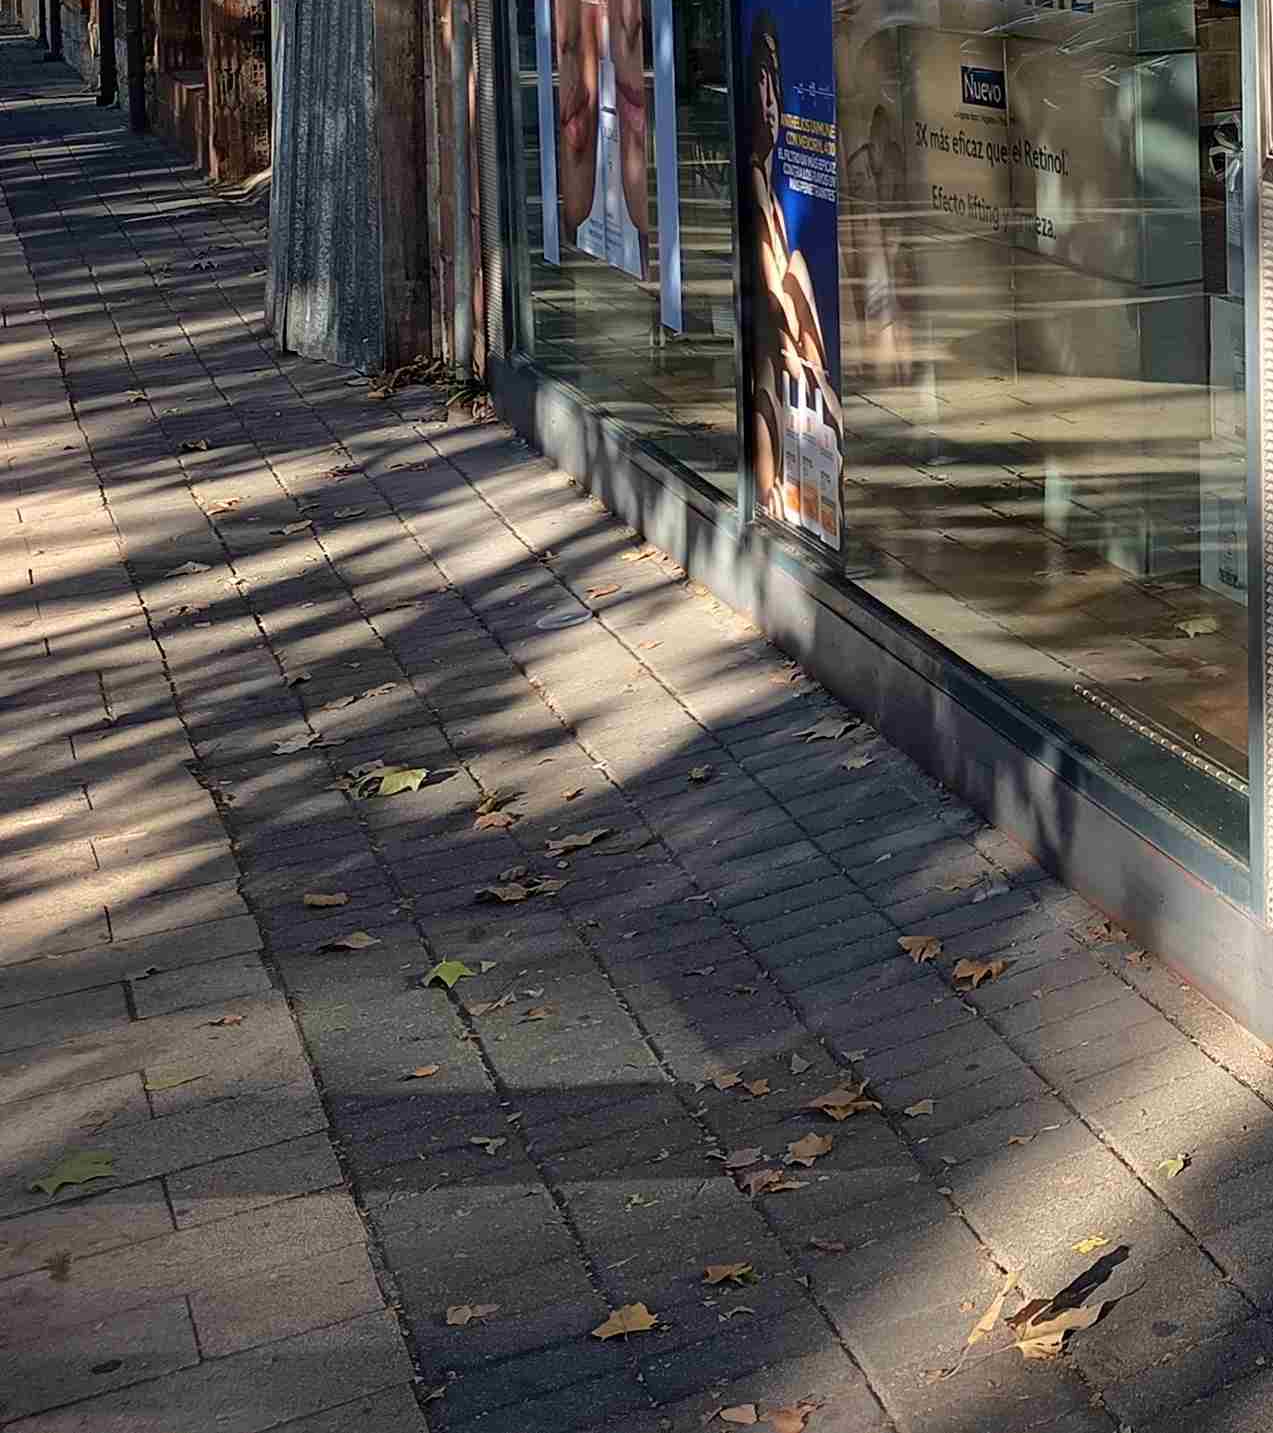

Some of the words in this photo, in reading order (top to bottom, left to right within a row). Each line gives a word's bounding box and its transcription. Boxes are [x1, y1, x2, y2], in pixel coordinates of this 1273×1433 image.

[963, 72, 1001, 104] Nuevo
[930, 127, 950, 152] más
[952, 130, 984, 160] eficaz
[986, 138, 1008, 167] que
[1010, 137, 1022, 163] el
[932, 184, 966, 215] Efecto
[968, 193, 1000, 231] lifting
